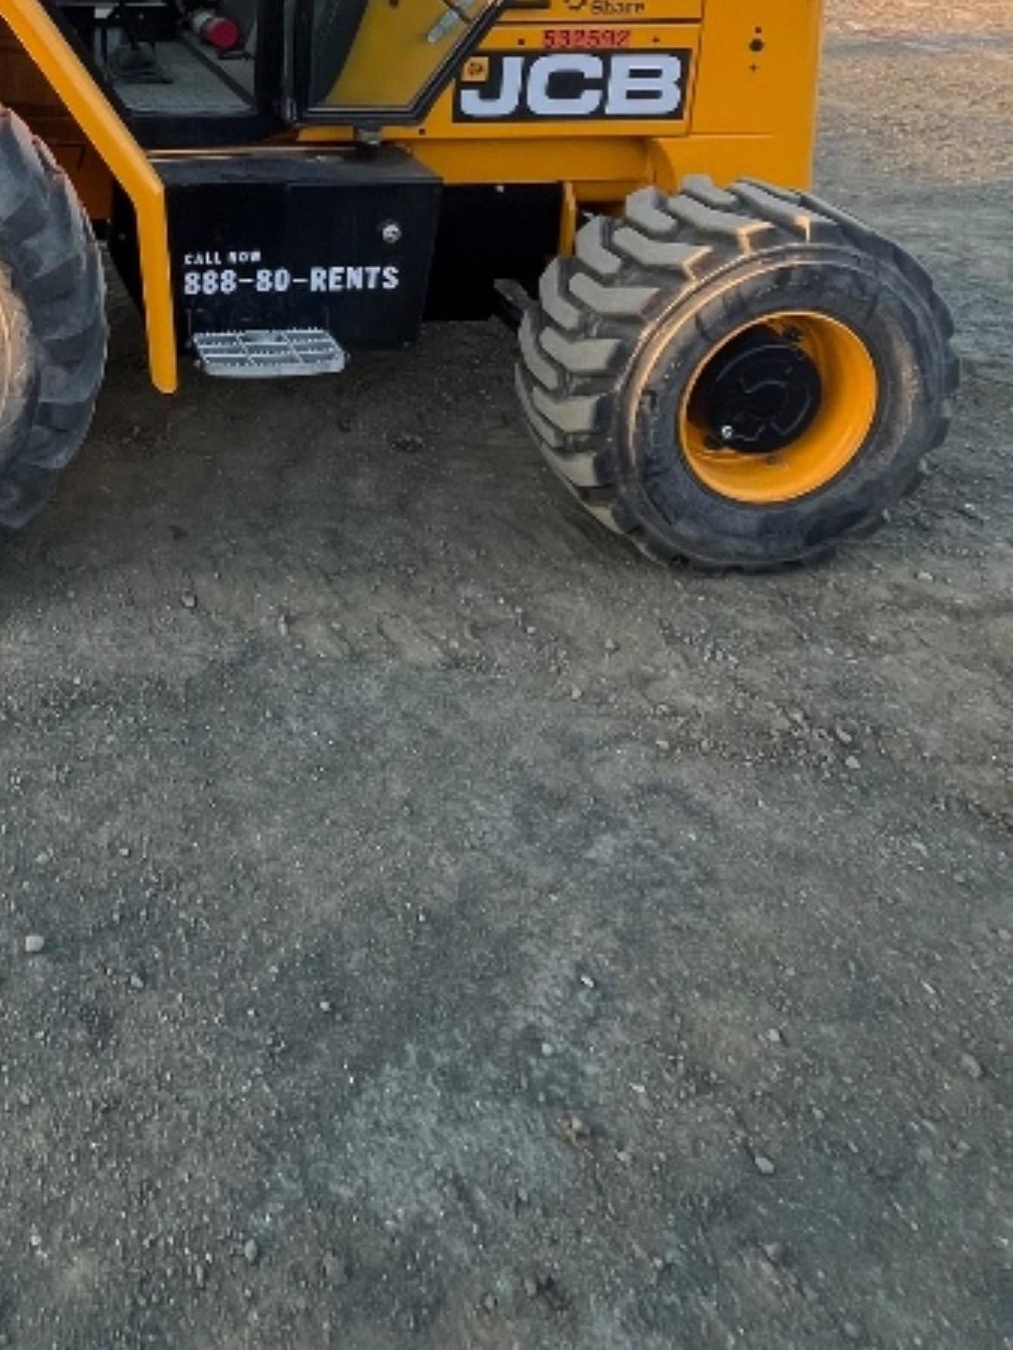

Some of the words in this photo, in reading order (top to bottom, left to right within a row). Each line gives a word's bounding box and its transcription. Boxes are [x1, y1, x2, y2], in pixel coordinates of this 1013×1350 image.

[591, 0, 646, 14] Share
[543, 29, 631, 49] 532592
[460, 54, 681, 117] JCB
[184, 251, 223, 266] CALL
[227, 250, 262, 263] NOW
[183, 265, 400, 296] 888-80-RENTS
